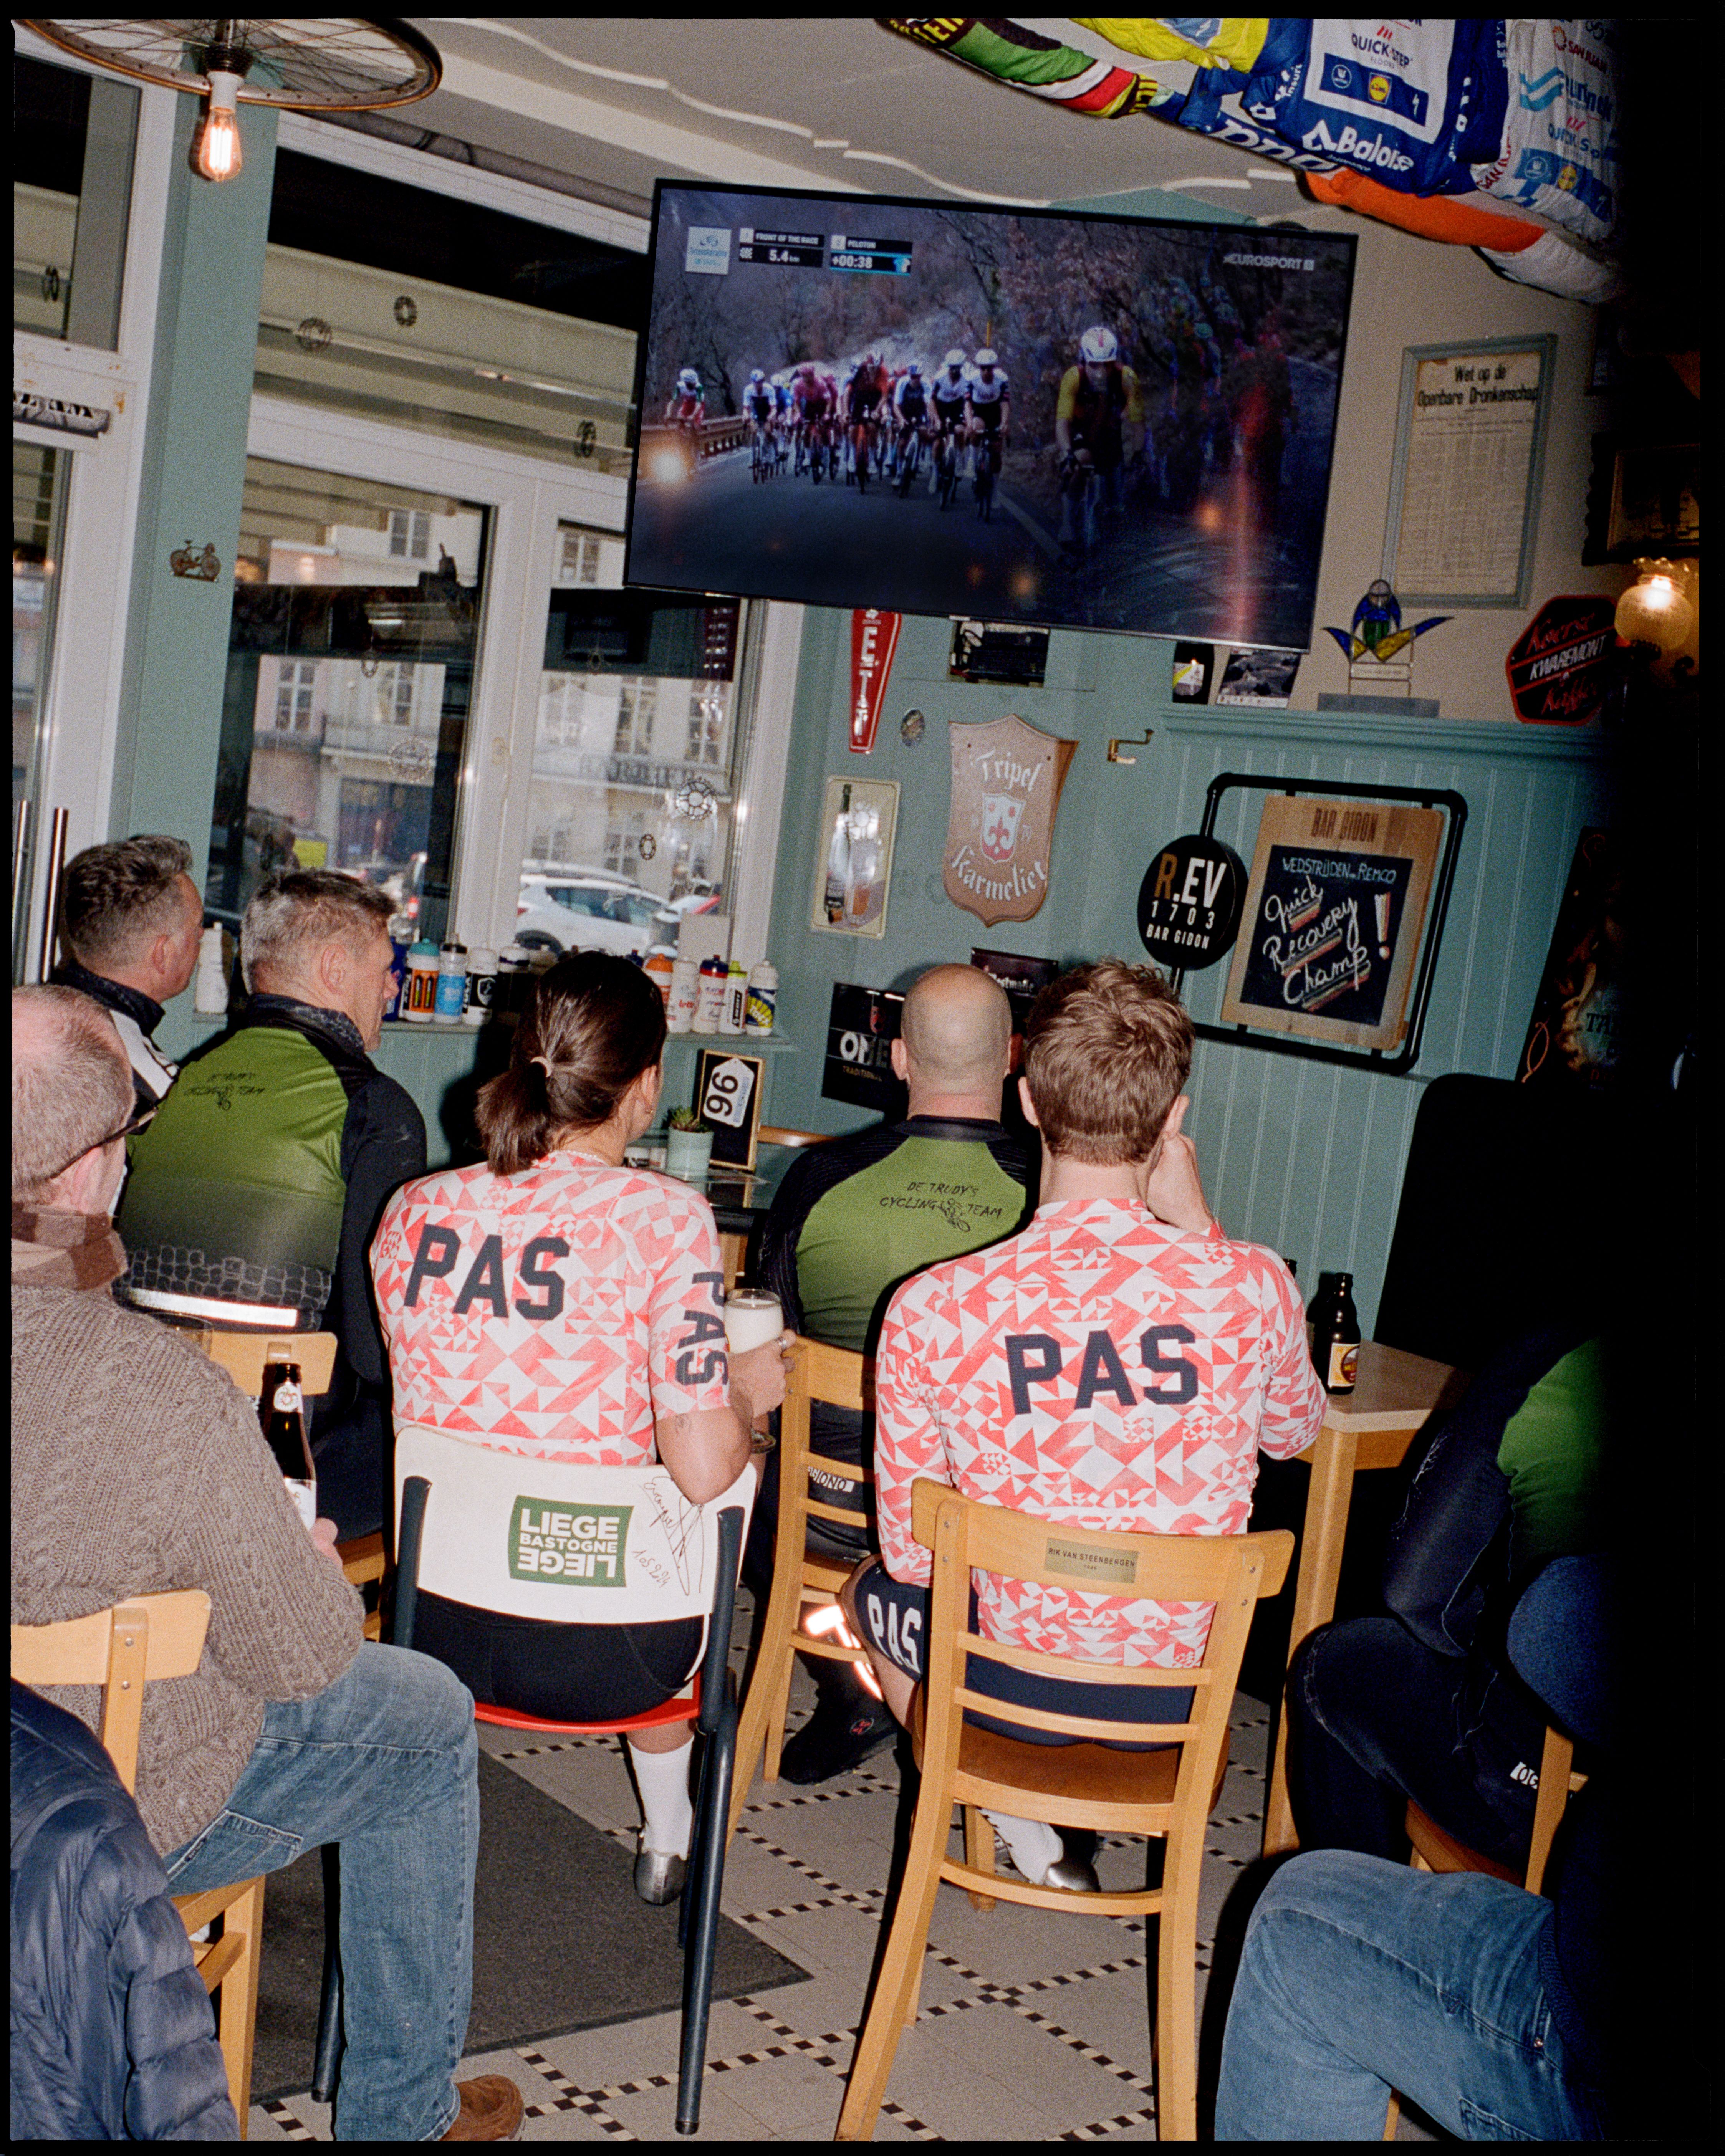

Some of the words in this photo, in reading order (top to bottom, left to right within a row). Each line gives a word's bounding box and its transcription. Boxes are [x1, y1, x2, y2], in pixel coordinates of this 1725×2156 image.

[1351, 33, 1389, 58] QUICK
[1335, 126, 1414, 172] Baloise
[755, 232, 776, 242] FRONT
[801, 237, 819, 245] RACE
[847, 239, 876, 249] PELOTON
[769, 249, 789, 262] 5.4
[1230, 253, 1303, 269] EUROSPORT
[1455, 363, 1474, 384] Wet
[1478, 367, 1491, 384] op
[1494, 362, 1506, 380] de
[1417, 388, 1463, 411] Openbare
[1529, 634, 1607, 682] KWAREMONT
[971, 749, 1042, 792] Tripel
[1311, 807, 1337, 839] BAR
[952, 844, 1046, 901] Karmeliet
[1265, 875, 1323, 934] Quick
[1146, 923, 1169, 941] BAR
[1174, 929, 1210, 950] GIDON
[1263, 896, 1358, 972] Recovery
[1283, 946, 1369, 1004] Champ
[907, 1181, 926, 1191] DE
[879, 1196, 937, 1211] CYCLING
[967, 1203, 1003, 1218] TEAM
[403, 1223, 571, 1321] PAS
[675, 1271, 730, 1386] PAS
[1005, 1324, 1199, 1415] PAS
[520, 1508, 620, 1540] LIEGE
[519, 1533, 617, 1553] BASTOGNE
[1048, 1547, 1061, 1555] RIK
[1063, 1550, 1077, 1559] VAN
[1079, 1553, 1135, 1567] STEENBERGEN
[517, 1546, 617, 1578] LIEGE
[867, 1593, 922, 1674] PAS
